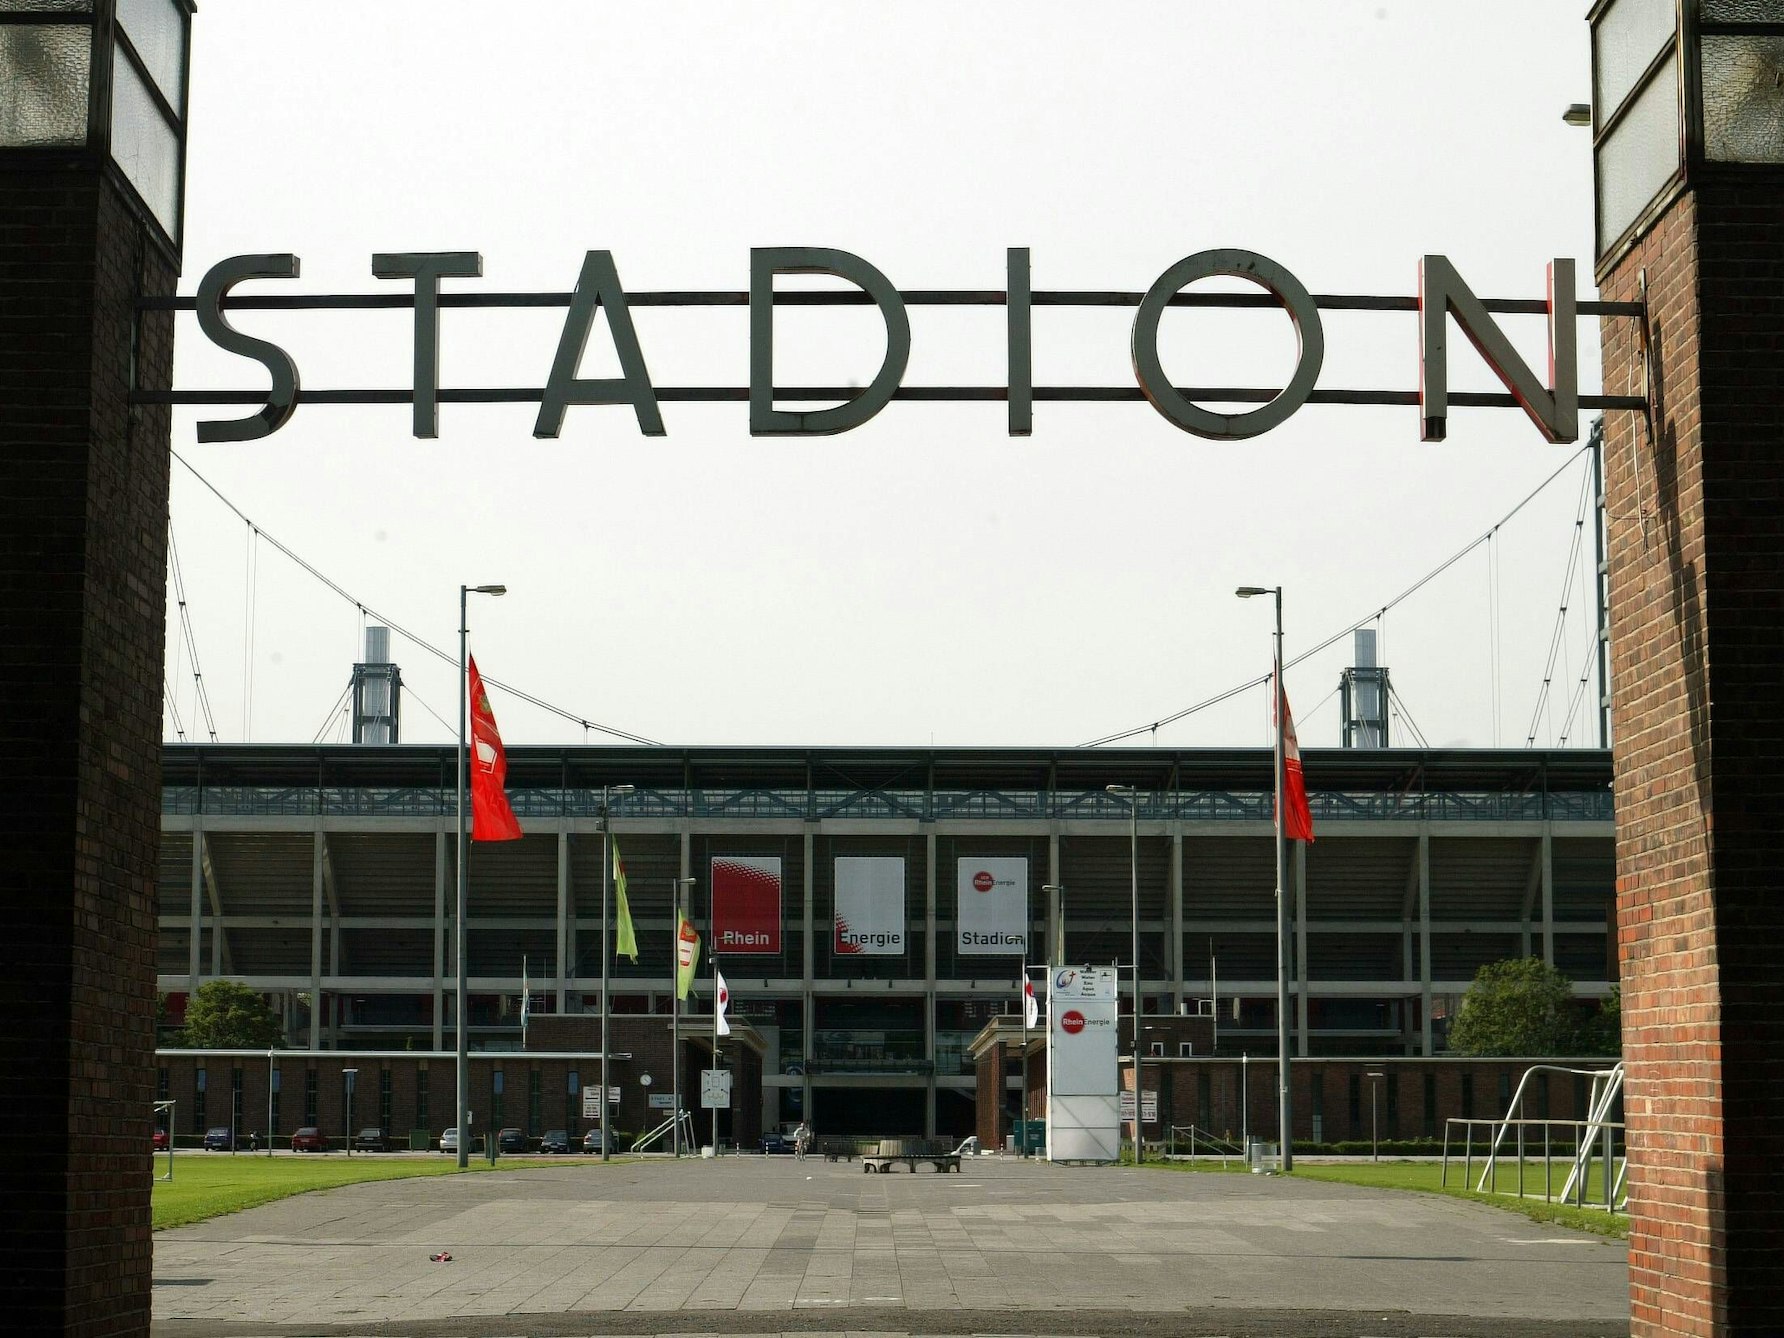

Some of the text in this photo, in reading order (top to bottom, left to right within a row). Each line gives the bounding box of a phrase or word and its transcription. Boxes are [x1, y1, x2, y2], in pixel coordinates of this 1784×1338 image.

[196, 247, 1579, 444] STADION
[723, 930, 770, 946] Rhein
[840, 930, 901, 948] Energie
[962, 931, 1024, 946] Stadion
[1062, 1018, 1110, 1026] RheinEnergie
